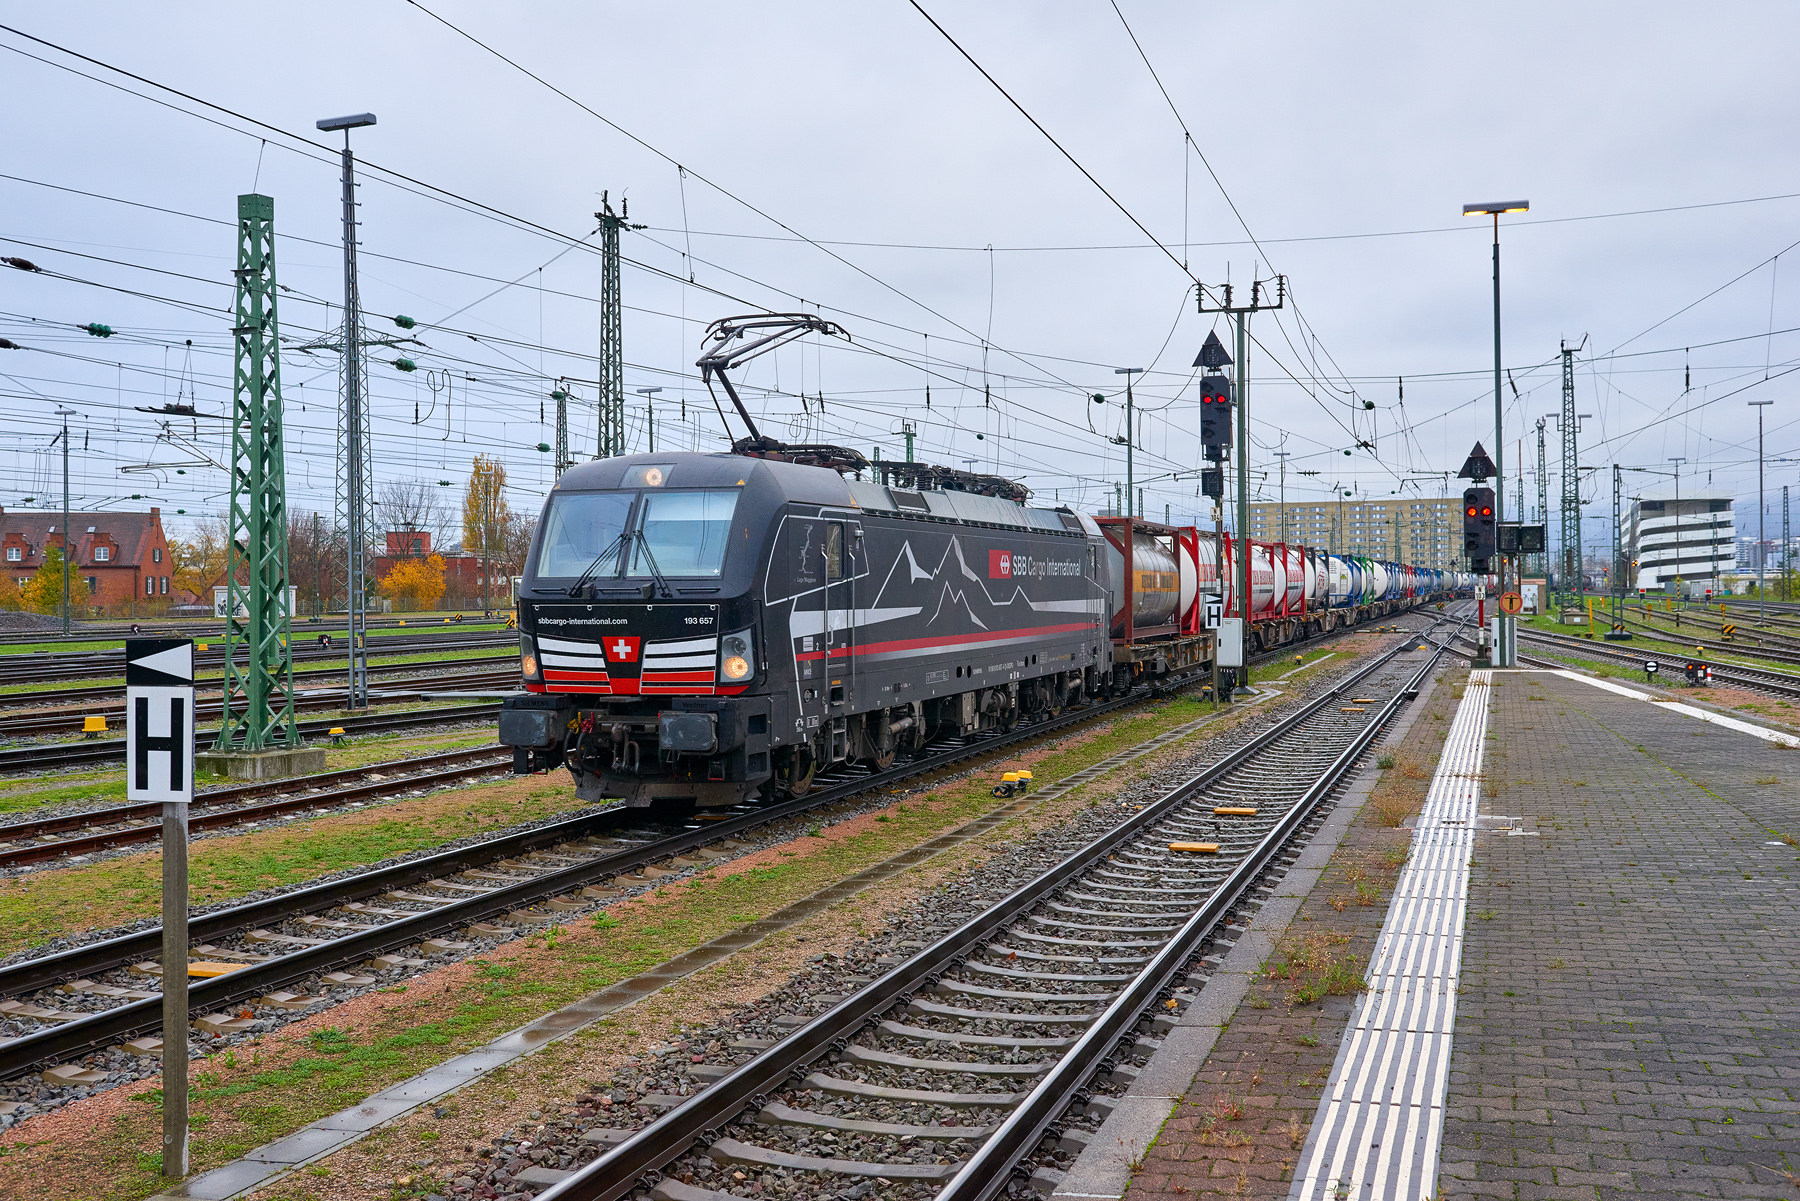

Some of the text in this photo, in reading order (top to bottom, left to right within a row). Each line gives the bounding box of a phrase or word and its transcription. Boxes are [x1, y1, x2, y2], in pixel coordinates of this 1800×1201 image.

[1012, 555, 1081, 580] SBB Cargo International
[538, 617, 628, 626] sbbcargo-international.com
[684, 617, 714, 625] 193 657
[1208, 606, 1221, 626] H
[135, 697, 184, 791] H
